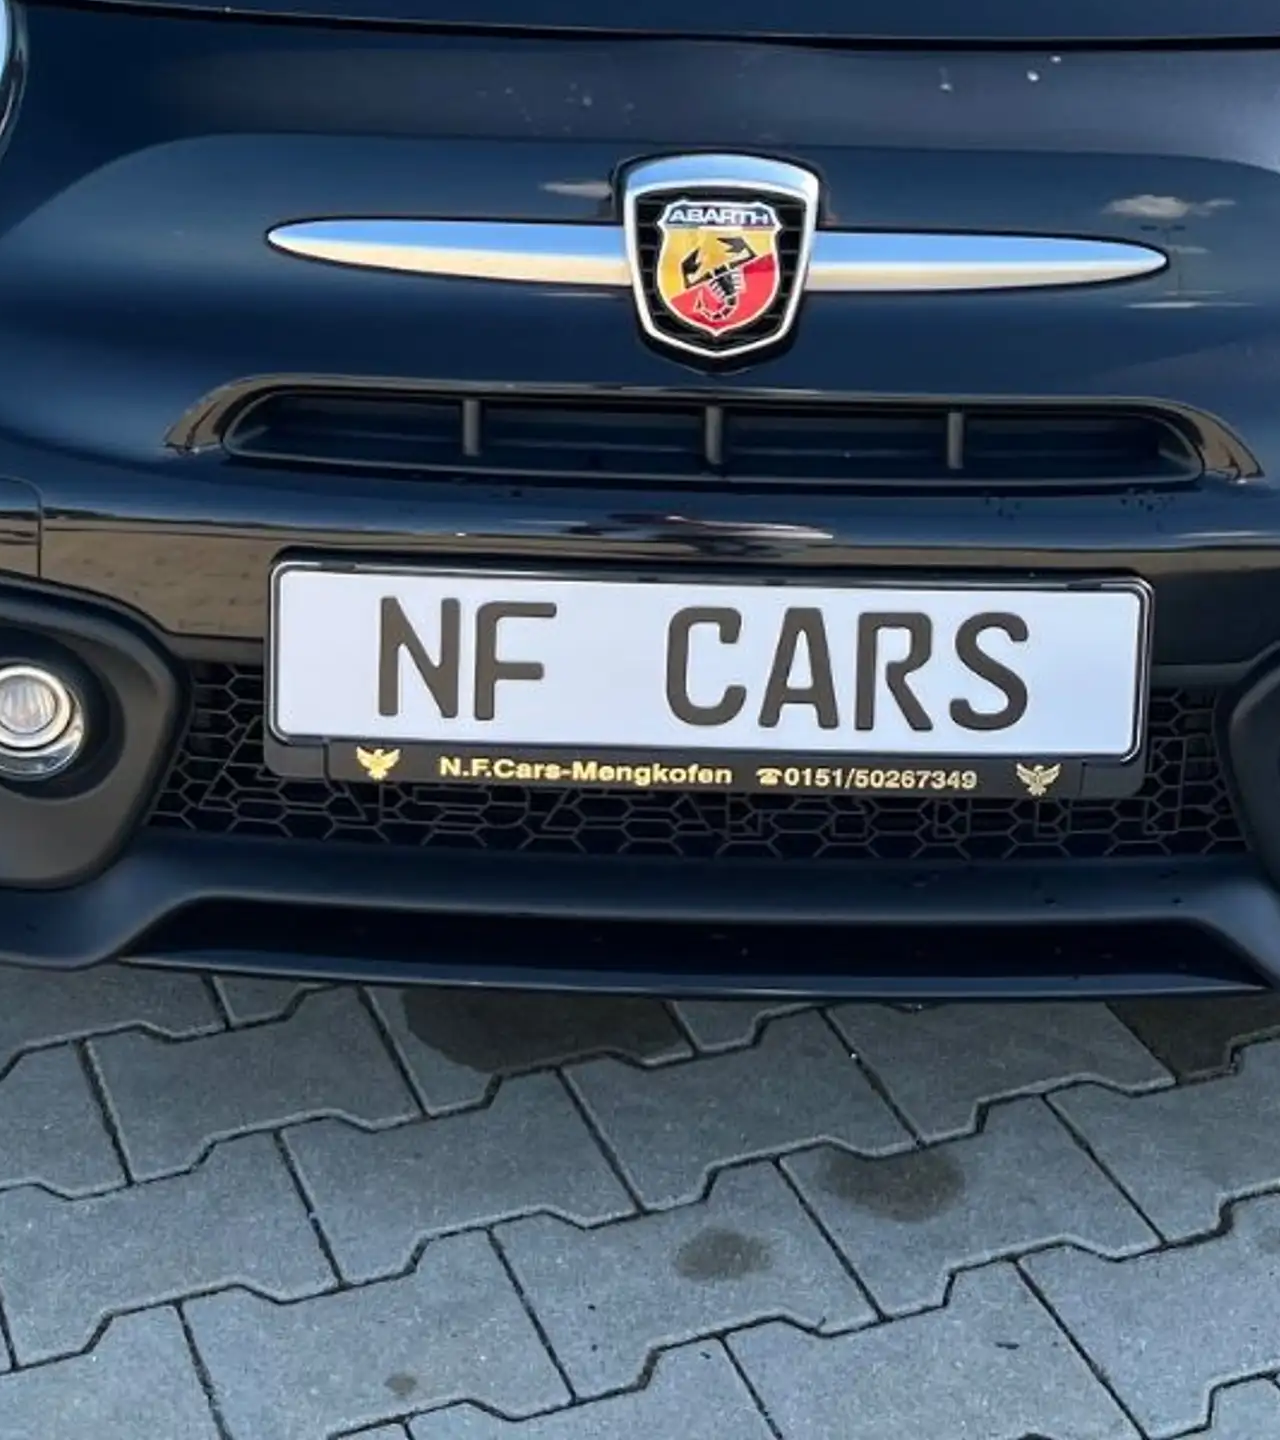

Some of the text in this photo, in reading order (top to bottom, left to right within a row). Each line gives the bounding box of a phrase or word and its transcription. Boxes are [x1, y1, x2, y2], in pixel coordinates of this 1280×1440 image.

[668, 207, 770, 226] ABARTH
[377, 595, 1029, 732] NF CARS
[438, 756, 979, 791] N.F.Cars-Mengkofen 0151/50267349
